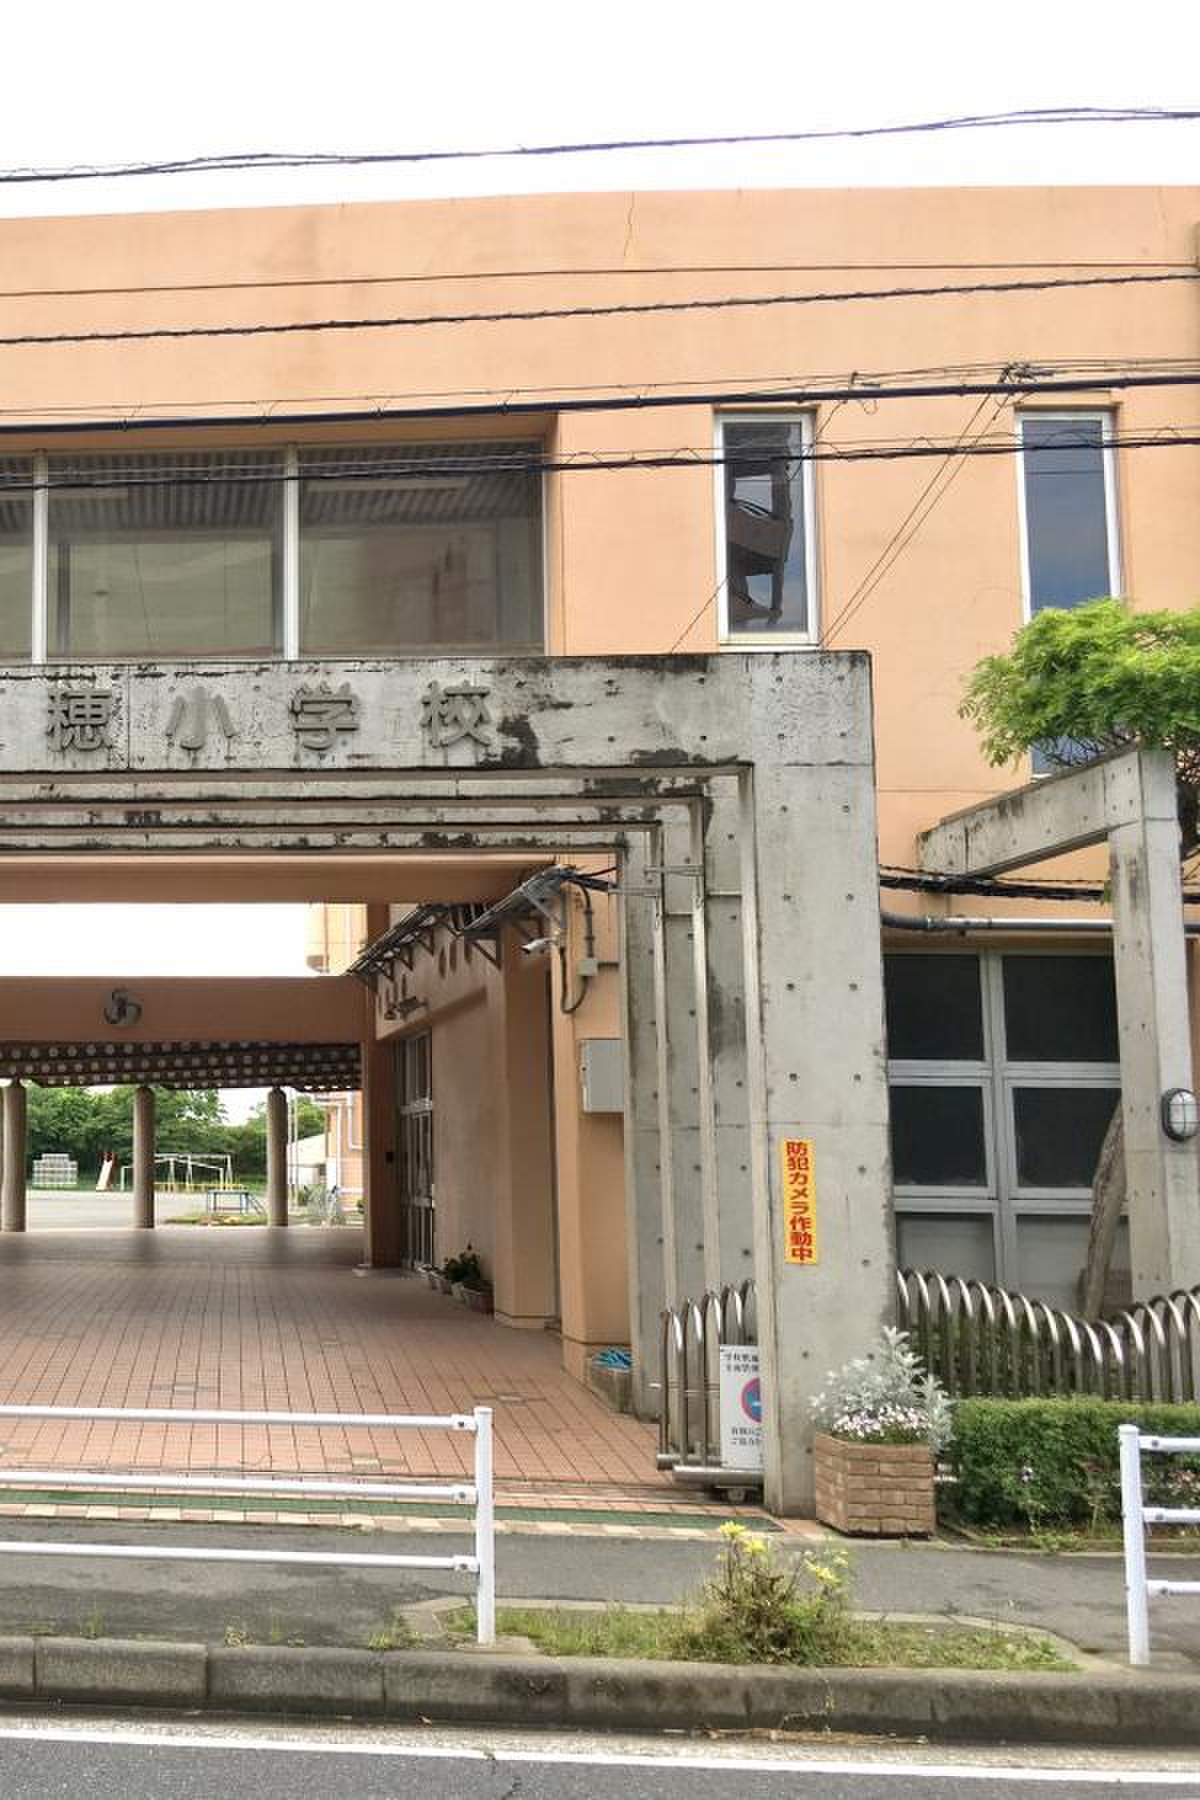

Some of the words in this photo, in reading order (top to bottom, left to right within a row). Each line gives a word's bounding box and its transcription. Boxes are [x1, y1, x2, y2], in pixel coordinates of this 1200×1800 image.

[786, 1141, 813, 1261] 防犯カメラ作動中
